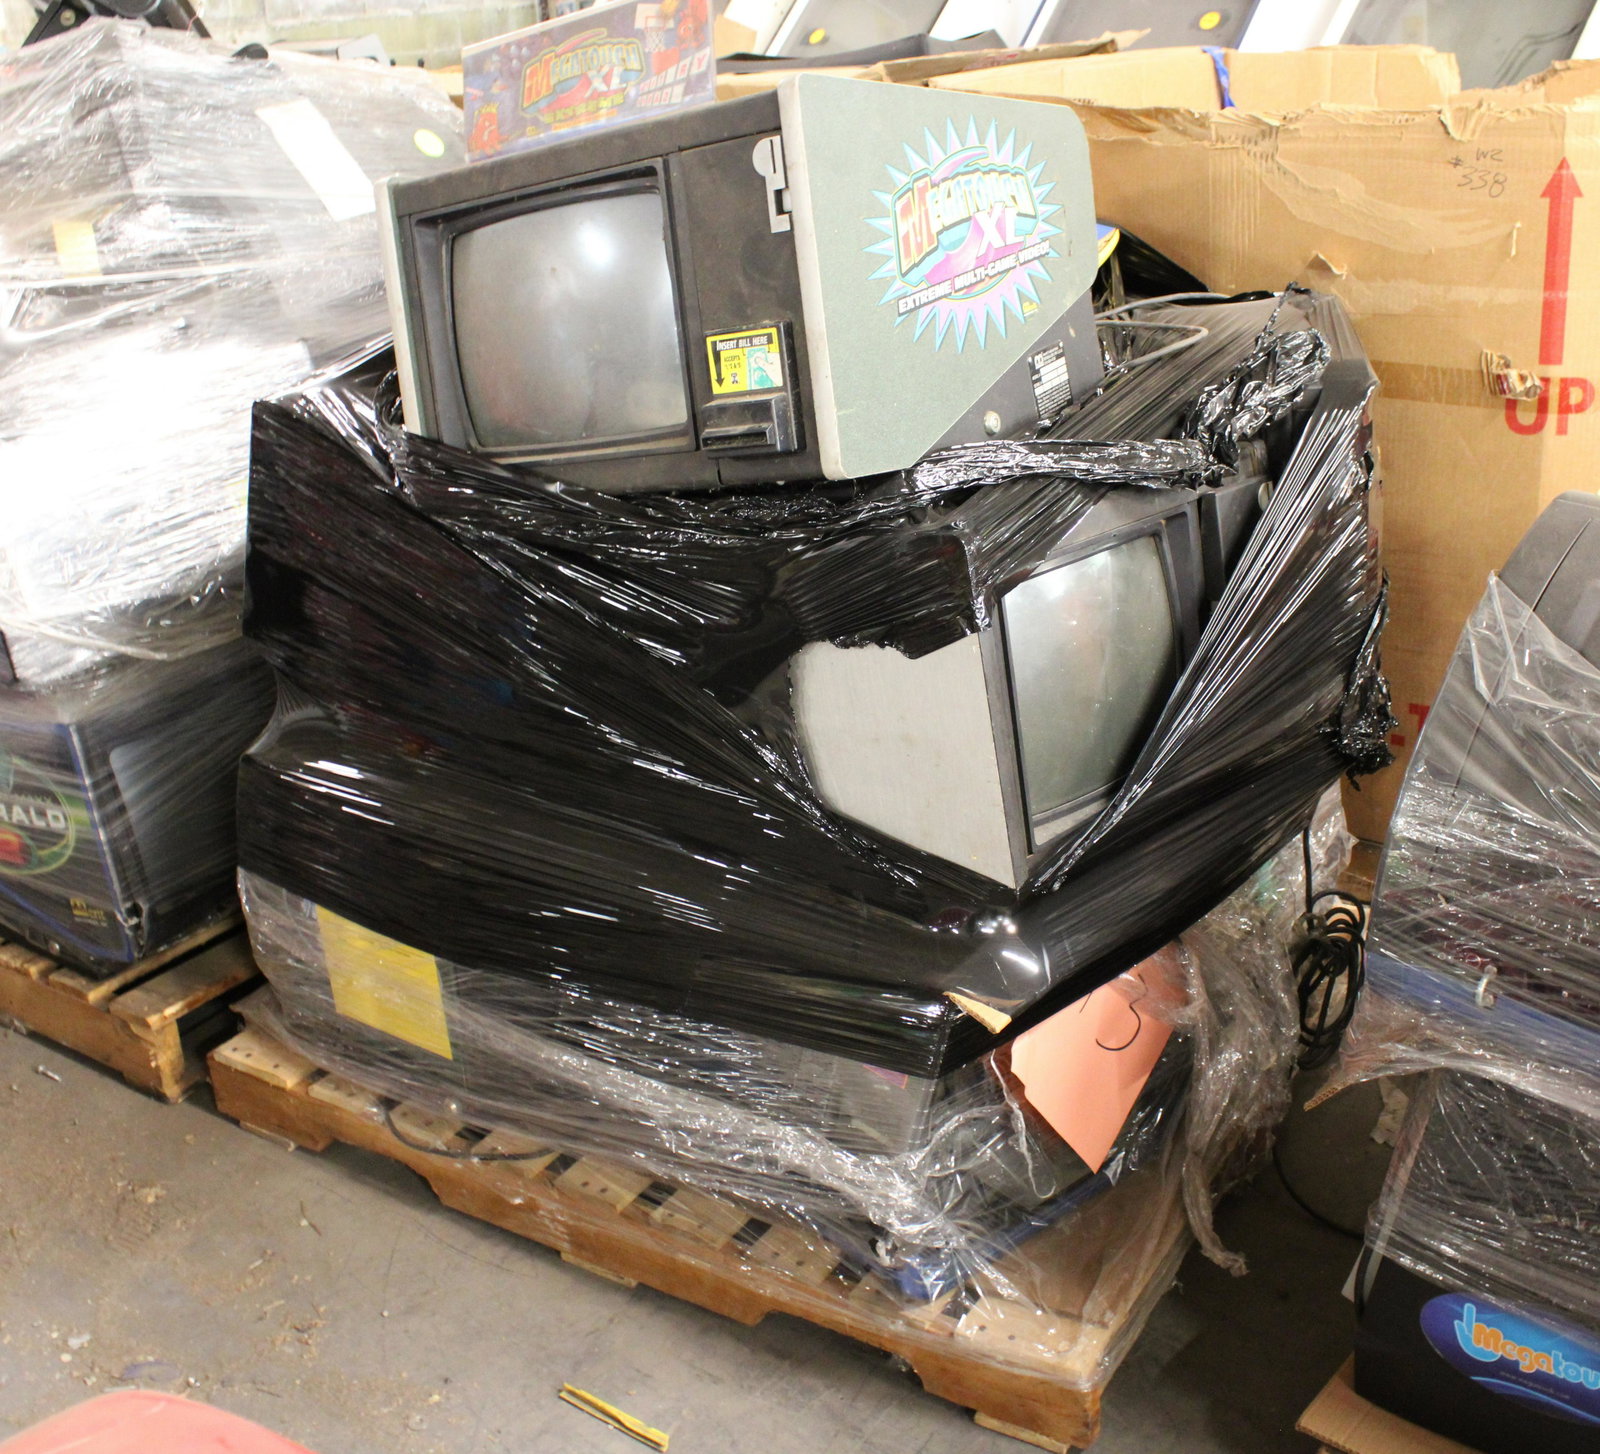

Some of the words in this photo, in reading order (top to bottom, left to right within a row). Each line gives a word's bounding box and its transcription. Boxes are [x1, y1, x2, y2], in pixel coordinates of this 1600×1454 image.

[584, 64, 628, 98] XL
[896, 172, 1037, 274] MEGATOUCH
[973, 202, 1026, 257] XL
[898, 280, 953, 314] EXTREME
[953, 254, 1018, 293] MULTI-GAME
[1017, 239, 1050, 265] VIDEO!
[716, 339, 738, 351] INSERT
[738, 337, 751, 348] BILL
[752, 335, 768, 346] HERE
[1505, 377, 1596, 436] UP
